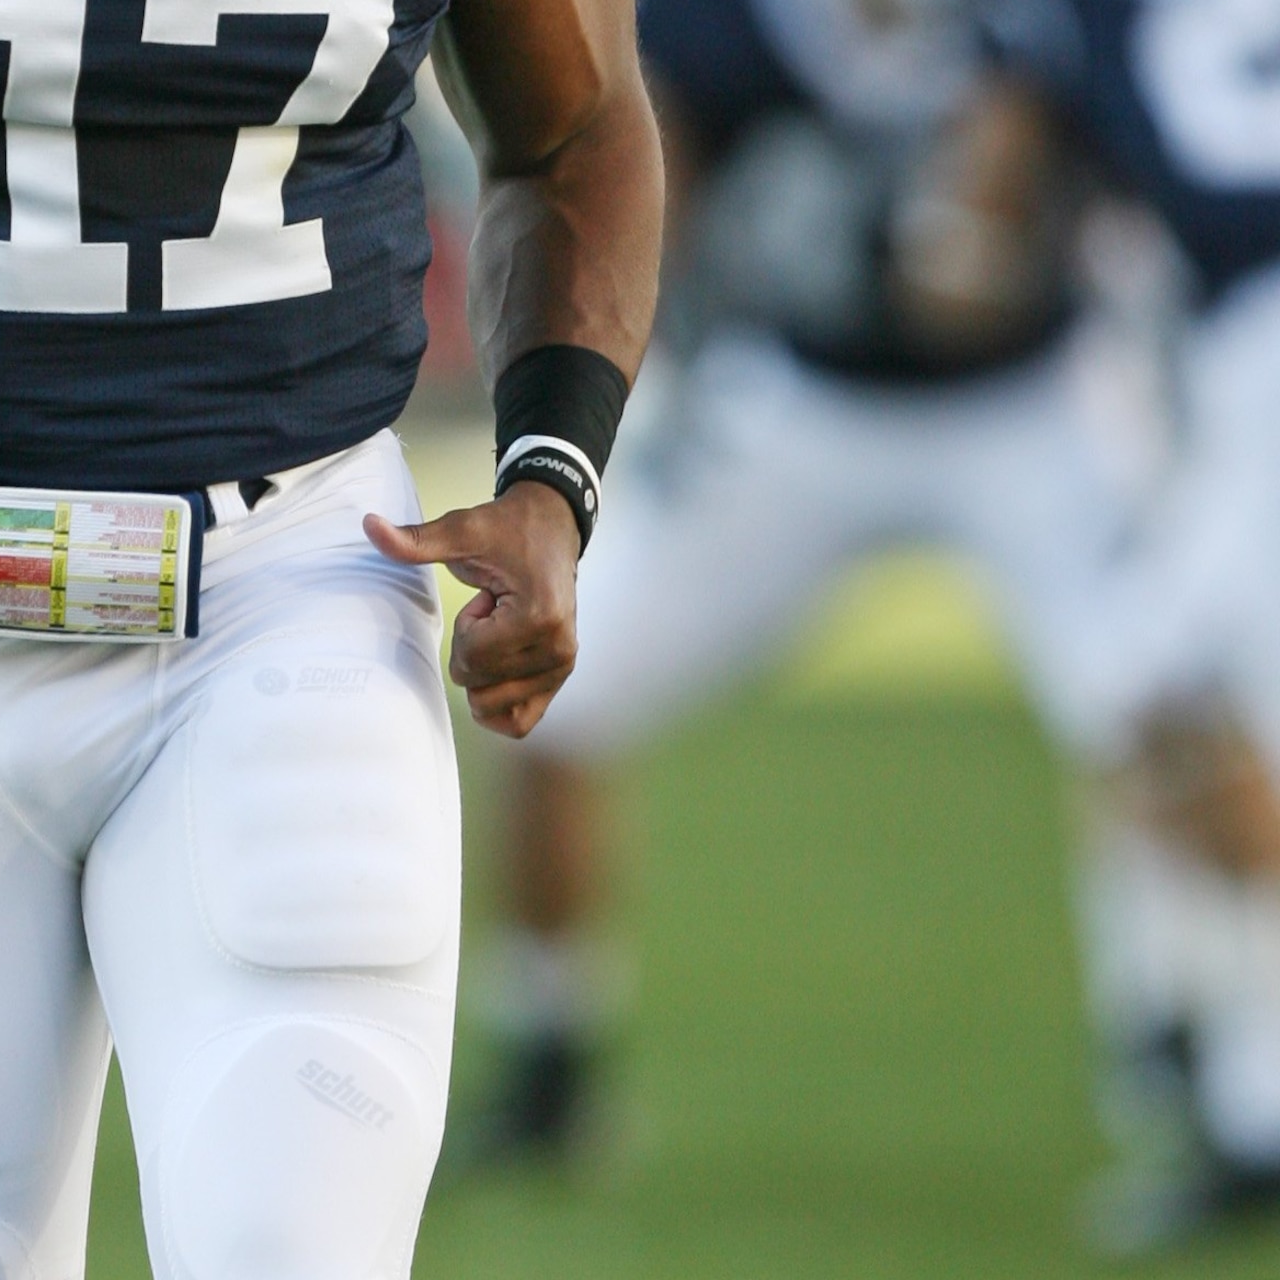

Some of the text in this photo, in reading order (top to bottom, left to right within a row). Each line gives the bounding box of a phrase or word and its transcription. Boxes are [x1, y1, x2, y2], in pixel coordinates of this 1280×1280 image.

[518, 456, 583, 489] POWER
[296, 666, 373, 685] SCHUTT
[297, 1059, 394, 1129] schutt
